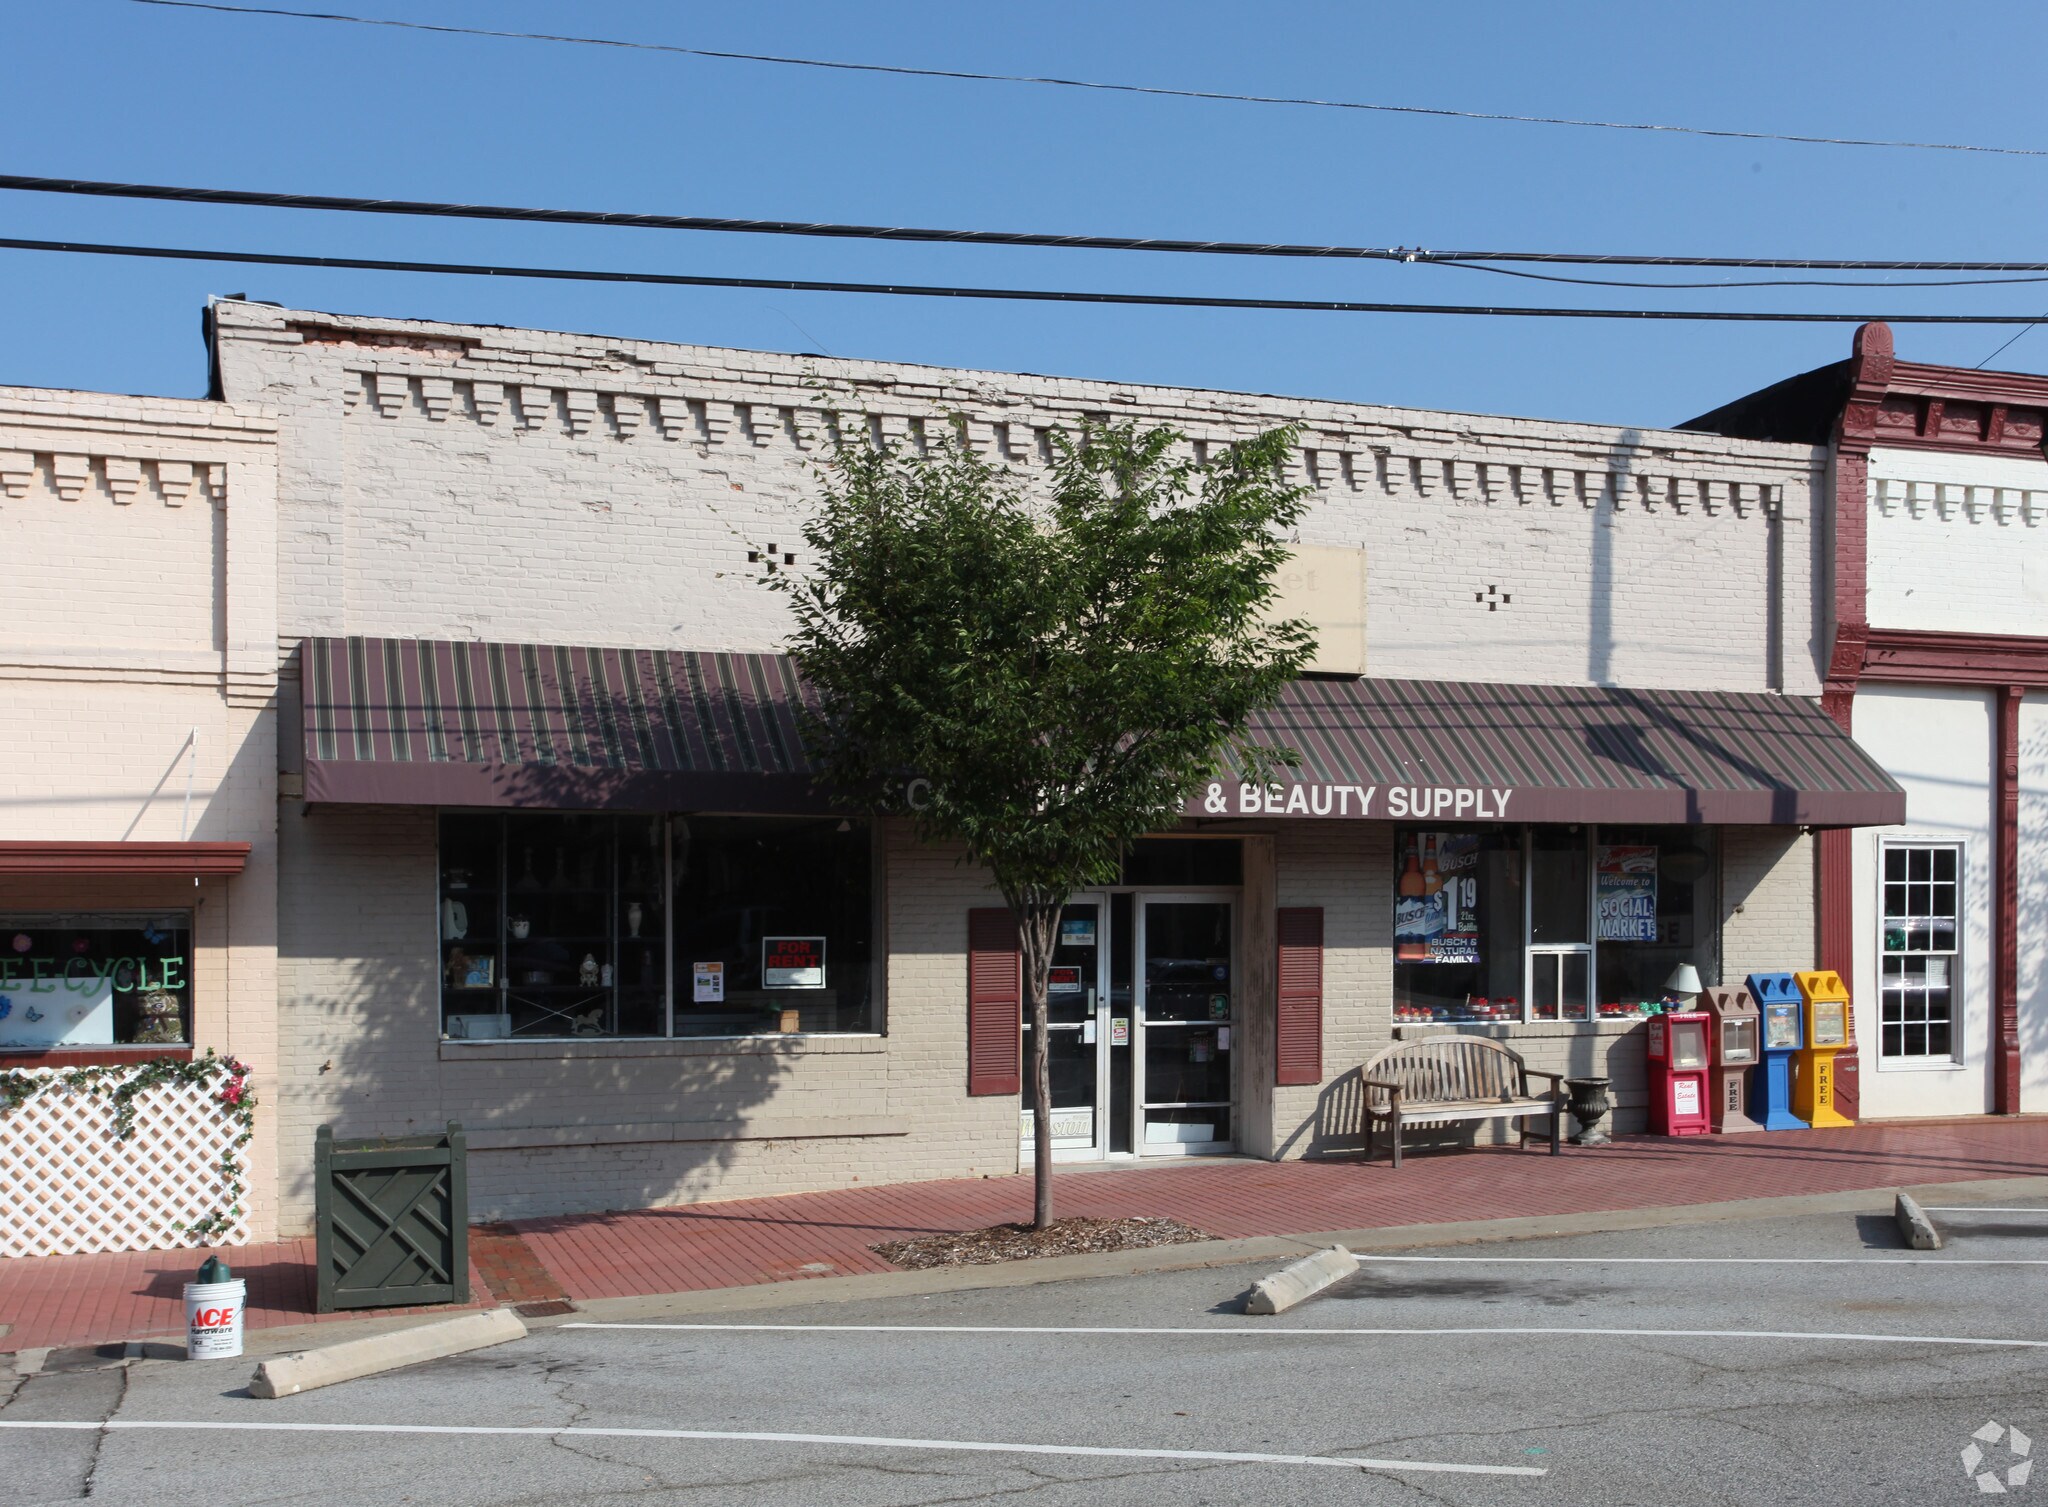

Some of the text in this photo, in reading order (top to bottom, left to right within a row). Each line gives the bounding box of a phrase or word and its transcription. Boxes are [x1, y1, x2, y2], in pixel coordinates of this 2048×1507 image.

[1204, 782, 1228, 814] &
[1239, 783, 1376, 816] BEAUTY
[1388, 786, 1513, 818] SUPPLY
[1441, 853, 1479, 872] BUSCH
[1601, 875, 1651, 886] Welcome to
[1601, 898, 1651, 918] SOCIAL
[1598, 919, 1654, 937] MARKET
[776, 941, 812, 954] FOR
[1431, 938, 1468, 946] BUSCH
[1430, 947, 1478, 955] NATURAL
[767, 954, 820, 968] RENT
[1435, 955, 1474, 964] FAMILY
[1819, 1065, 1828, 1104] FREE
[1728, 1081, 1738, 1111] FREE
[191, 1307, 234, 1327] ACE
[190, 1326, 233, 1335] Hardware
